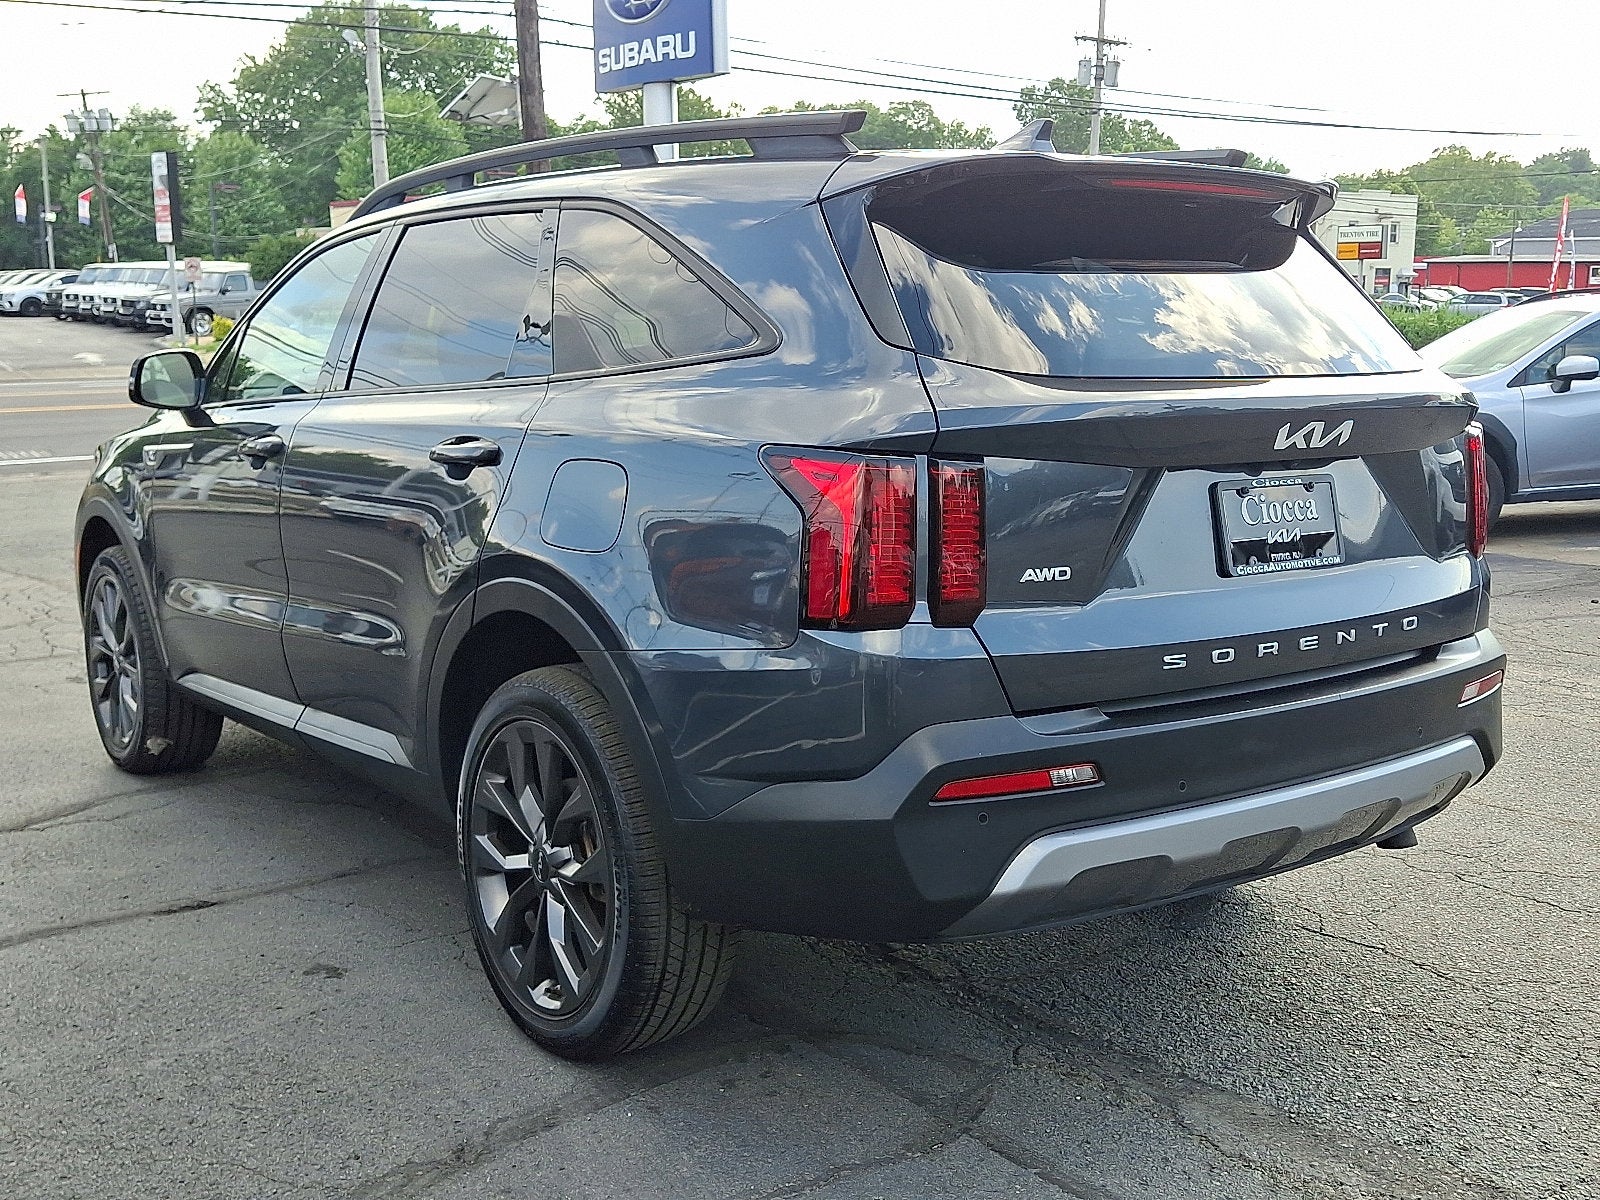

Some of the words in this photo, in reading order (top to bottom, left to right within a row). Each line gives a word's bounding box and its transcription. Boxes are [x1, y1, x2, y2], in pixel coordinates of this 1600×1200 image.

[598, 31, 696, 74] SUBARU
[1273, 420, 1354, 450] KIA
[1241, 494, 1319, 525] Ciocca
[1267, 528, 1302, 544] KIA
[1019, 566, 1072, 583] AWD
[1162, 616, 1418, 670] SORENTO
